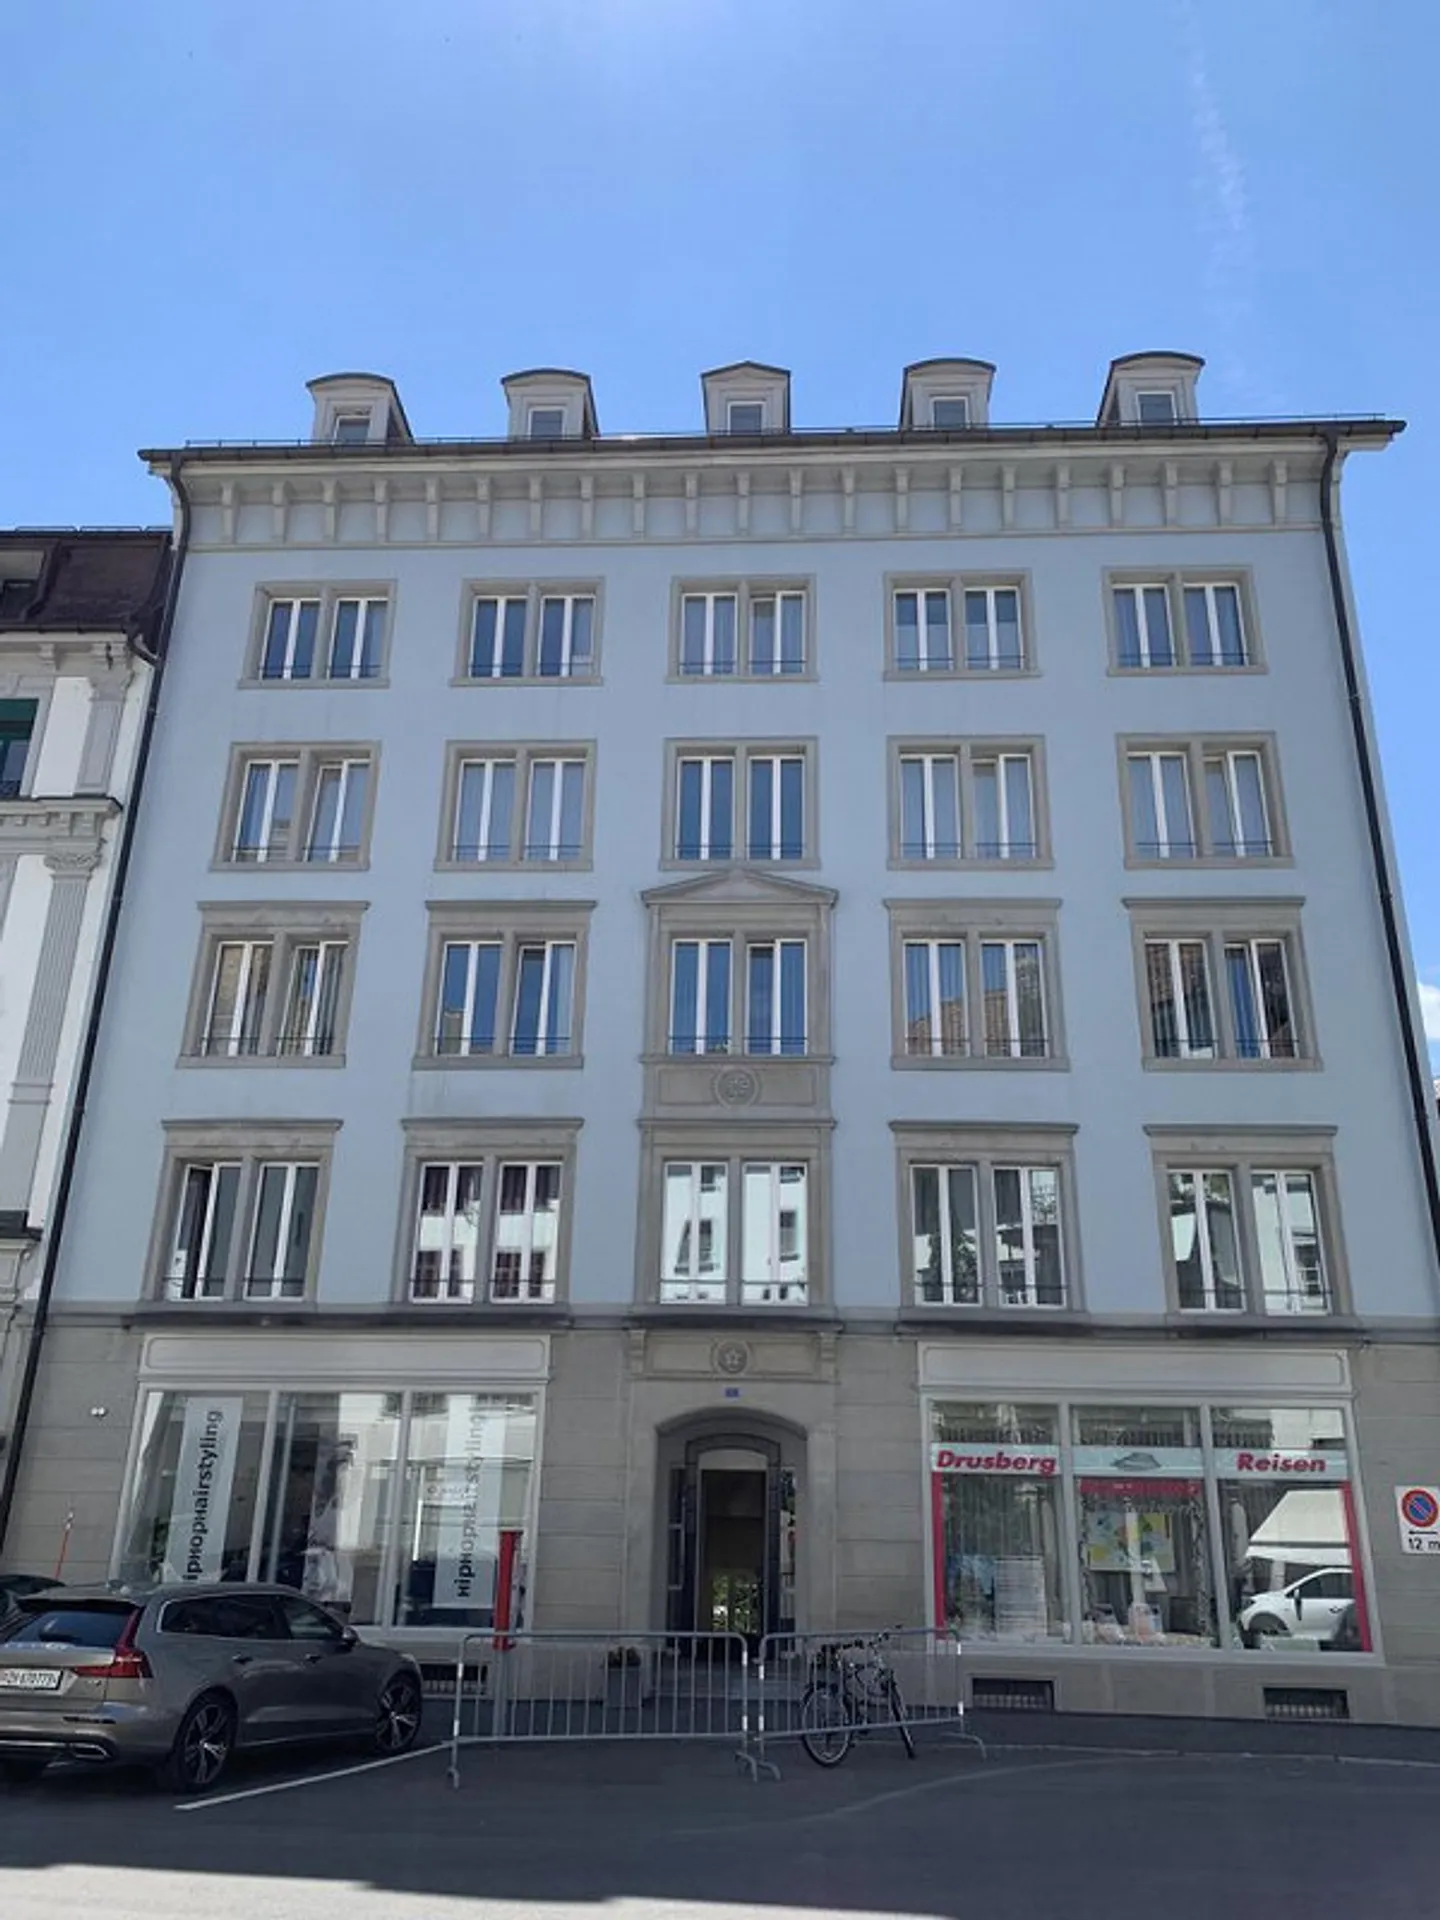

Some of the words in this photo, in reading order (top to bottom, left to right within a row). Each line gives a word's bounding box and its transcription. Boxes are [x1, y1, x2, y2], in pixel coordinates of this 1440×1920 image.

[936, 1449, 1056, 1477] Drusberg
[1236, 1451, 1326, 1472] Reisen
[1408, 1537, 1423, 1550] 12
